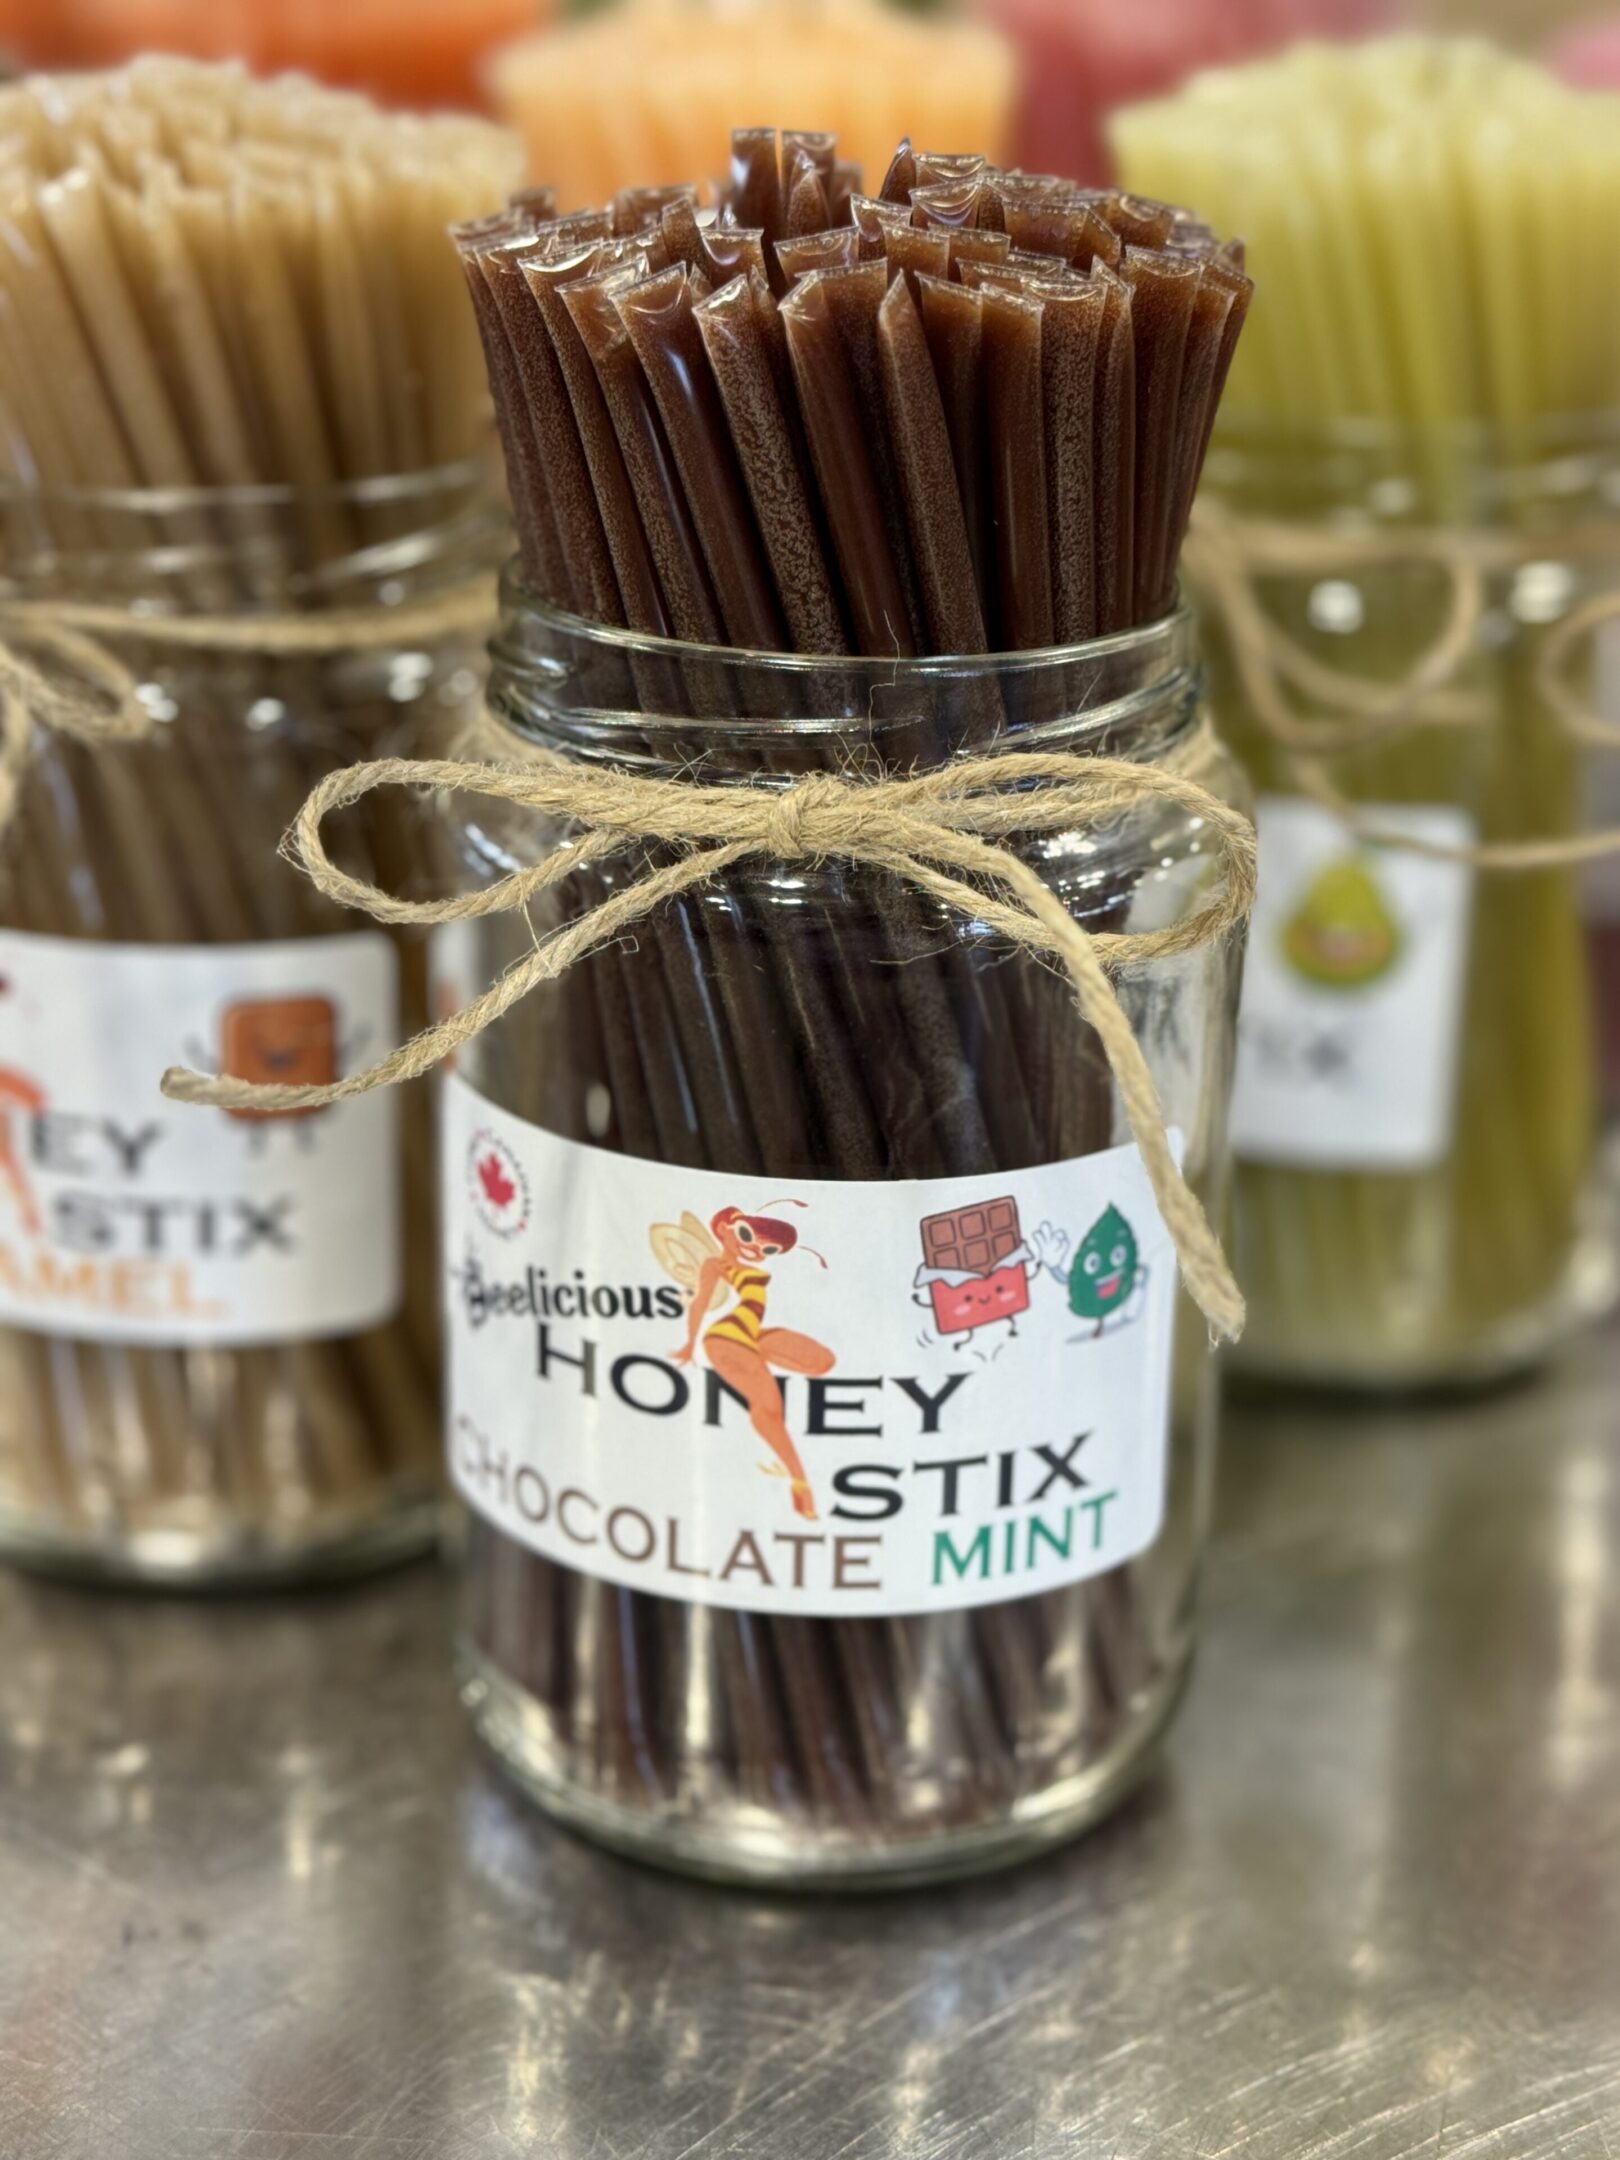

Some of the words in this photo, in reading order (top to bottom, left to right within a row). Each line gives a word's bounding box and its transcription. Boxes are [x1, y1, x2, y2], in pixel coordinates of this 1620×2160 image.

[31, 1114, 162, 1177] EY
[54, 1190, 293, 1256] STIX
[454, 1245, 685, 1329] Beelicious
[535, 1323, 975, 1436] HONEY
[829, 1428, 1095, 1522] STIX
[930, 1489, 1120, 1586] MINT
